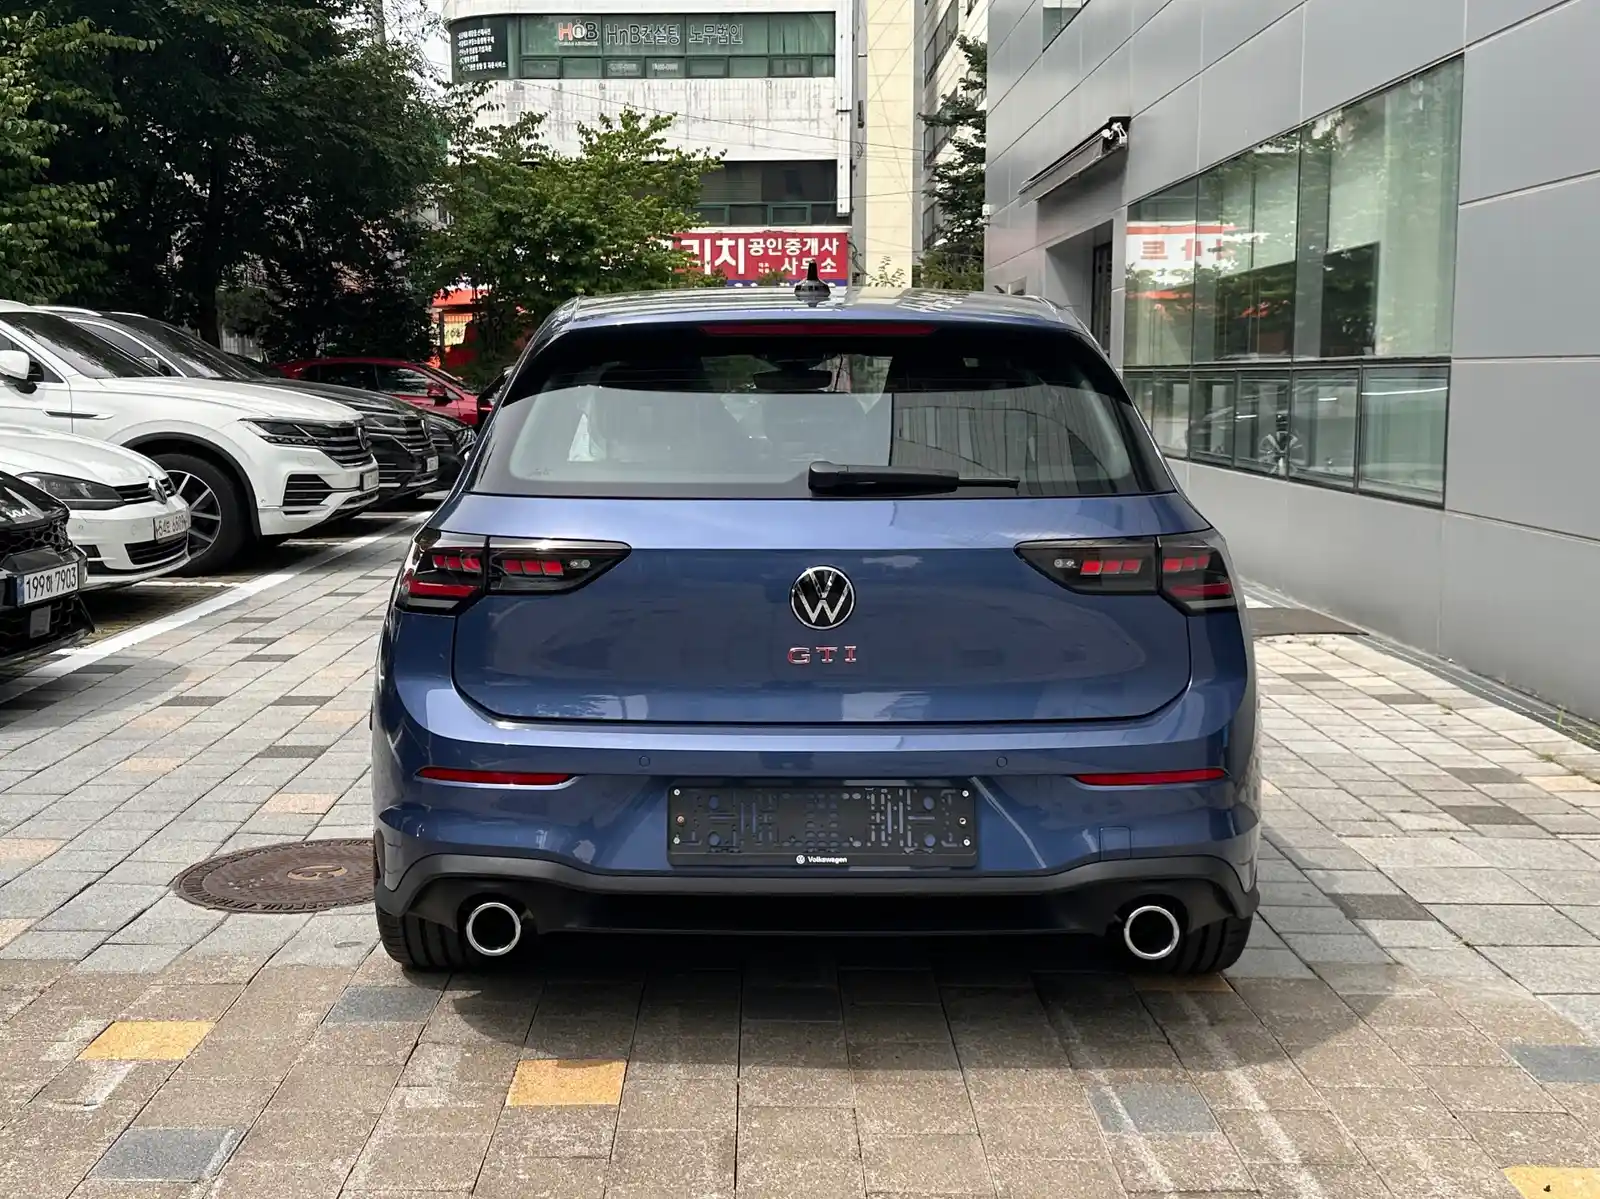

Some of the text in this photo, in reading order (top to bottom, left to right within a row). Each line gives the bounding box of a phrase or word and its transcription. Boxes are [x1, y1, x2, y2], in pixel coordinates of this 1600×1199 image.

[605, 23, 743, 45] HnB컨설팅 노무법인
[660, 236, 839, 275] 리치 공인중개사
[55, 567, 76, 592] 7903
[787, 645, 857, 664] GTI
[807, 855, 848, 865] Volkswagen
